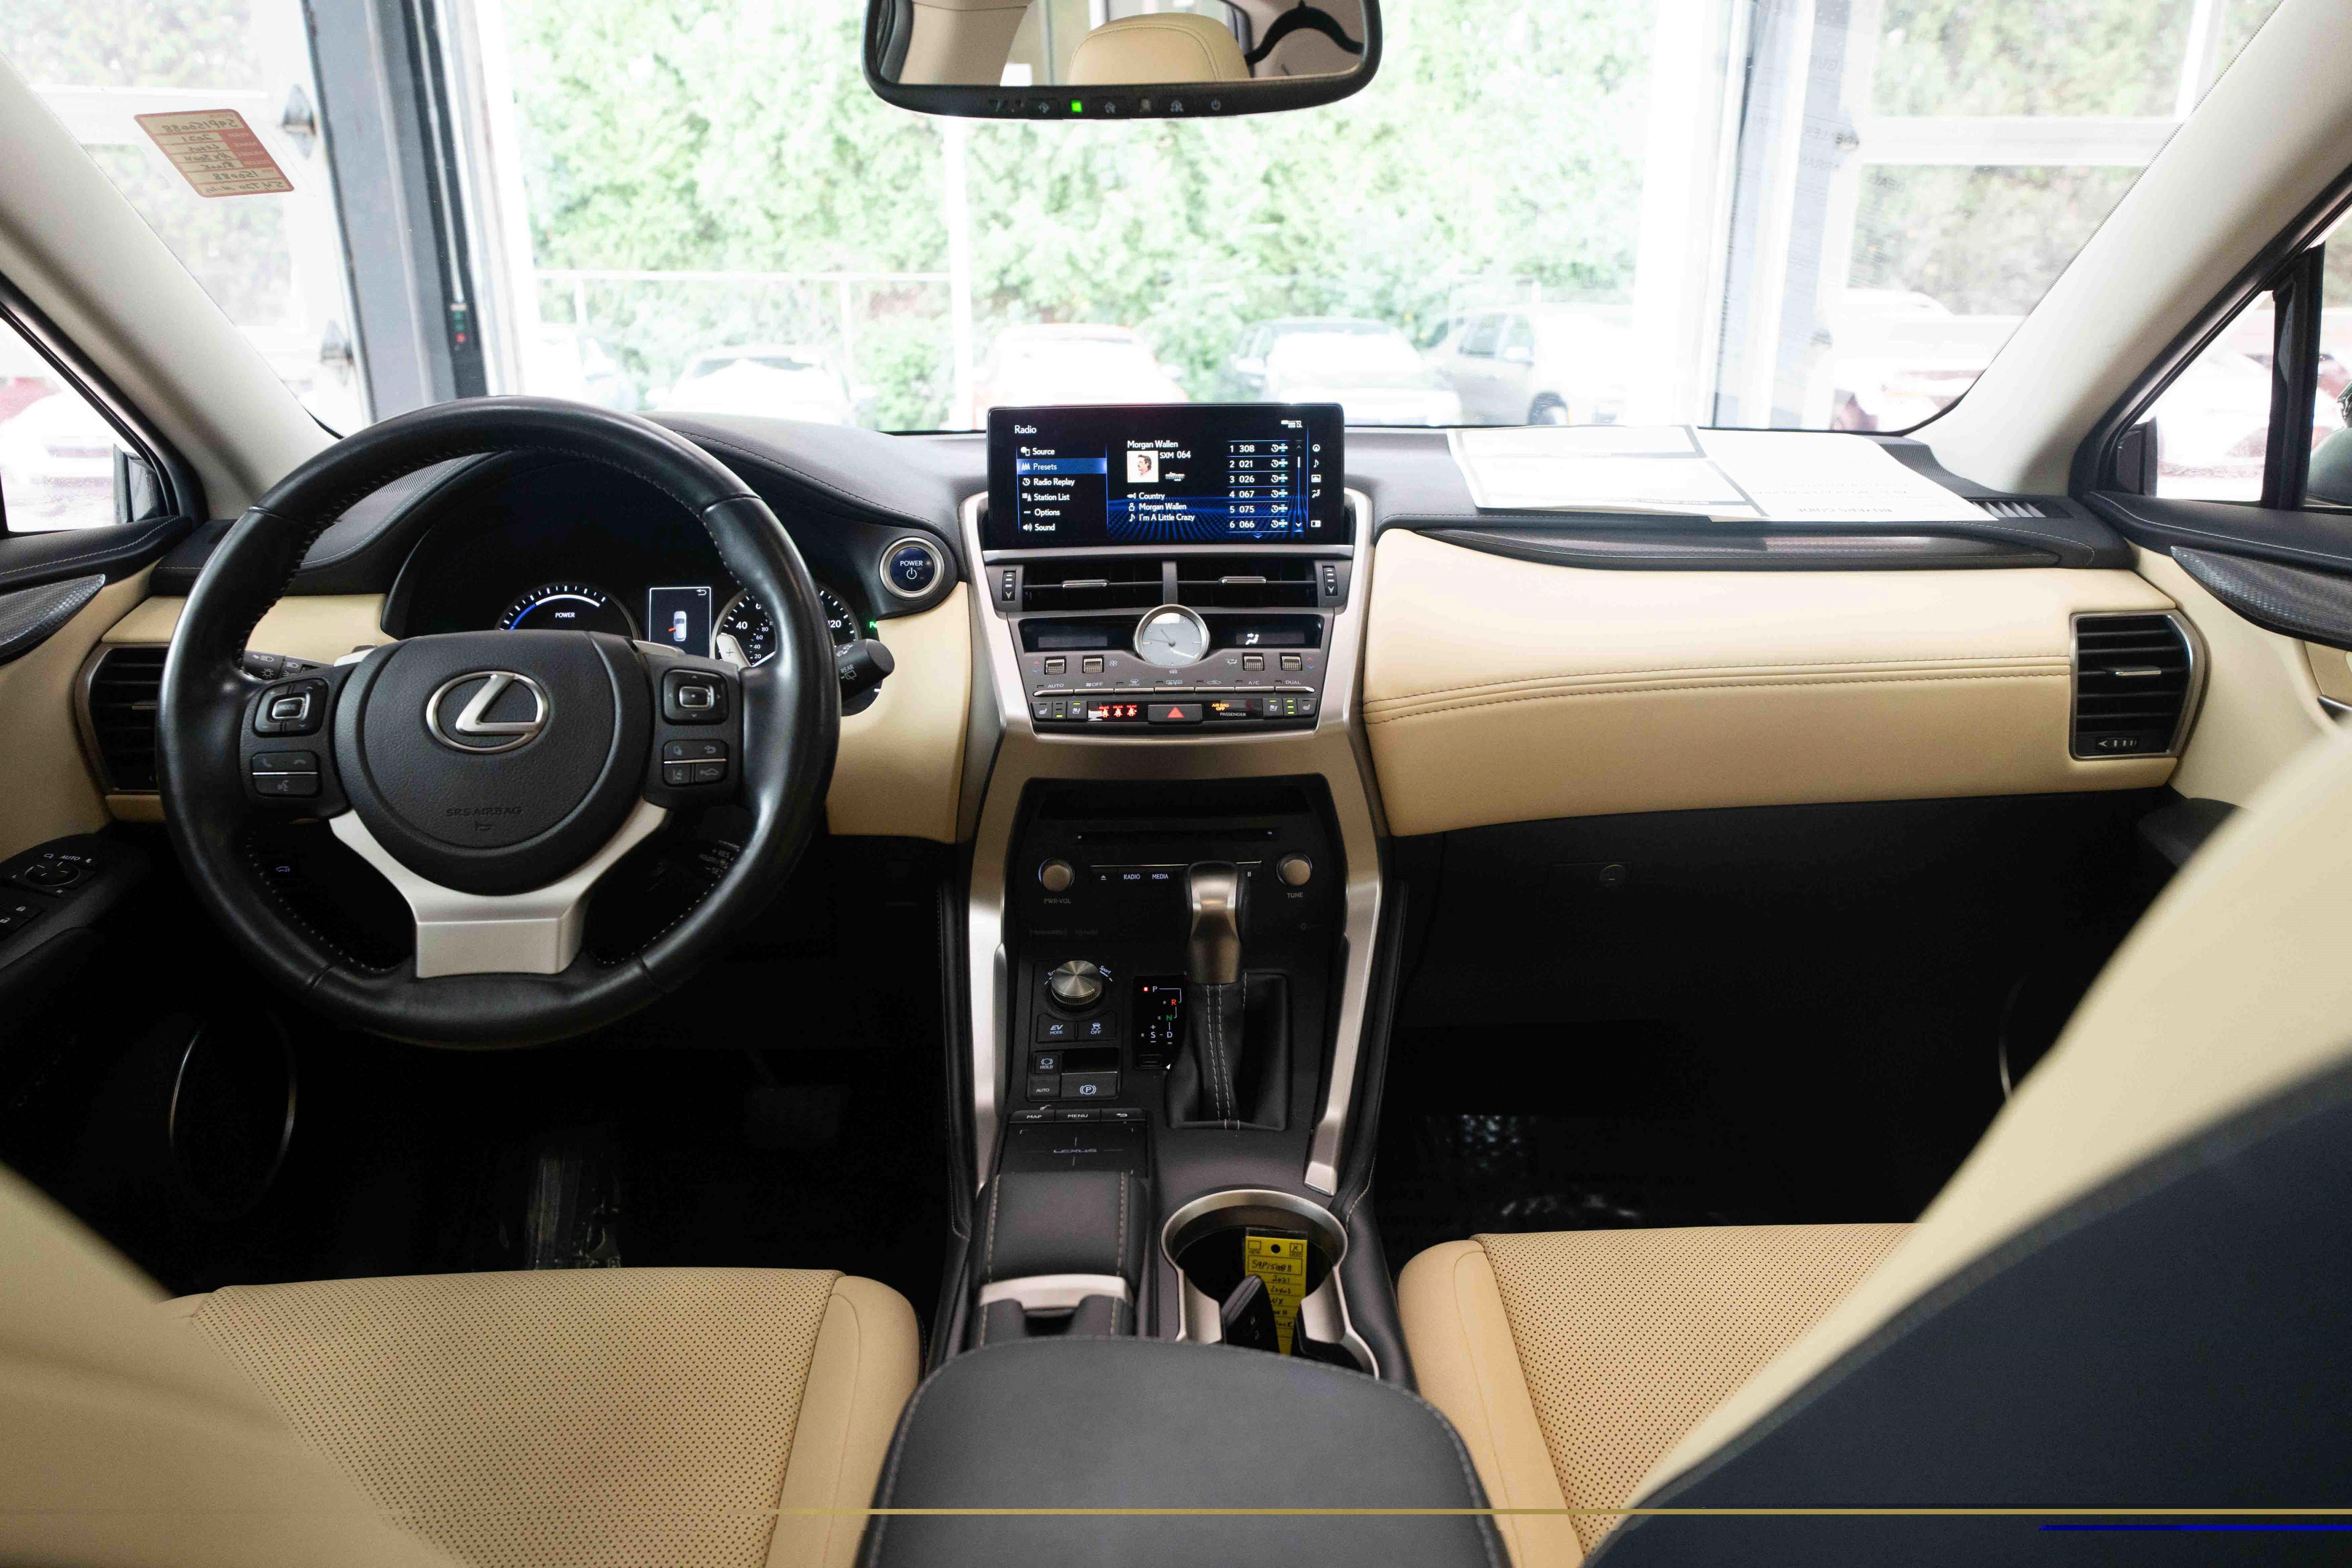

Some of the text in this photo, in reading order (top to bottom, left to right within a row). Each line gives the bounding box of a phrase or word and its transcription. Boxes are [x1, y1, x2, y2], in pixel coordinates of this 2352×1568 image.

[1015, 425, 1037, 434] Radio
[1127, 440, 1178, 449] Morgan Wallen
[1177, 450, 1191, 459] 064
[1053, 478, 1075, 487] Replay
[1139, 503, 1164, 512] Morgan
[1034, 508, 1060, 517] Options
[1176, 513, 1195, 522] Crazy
[1035, 523, 1056, 531] Sound
[736, 621, 748, 629] 40
[840, 664, 855, 674] REAR
[1099, 965, 1111, 974] Sport
